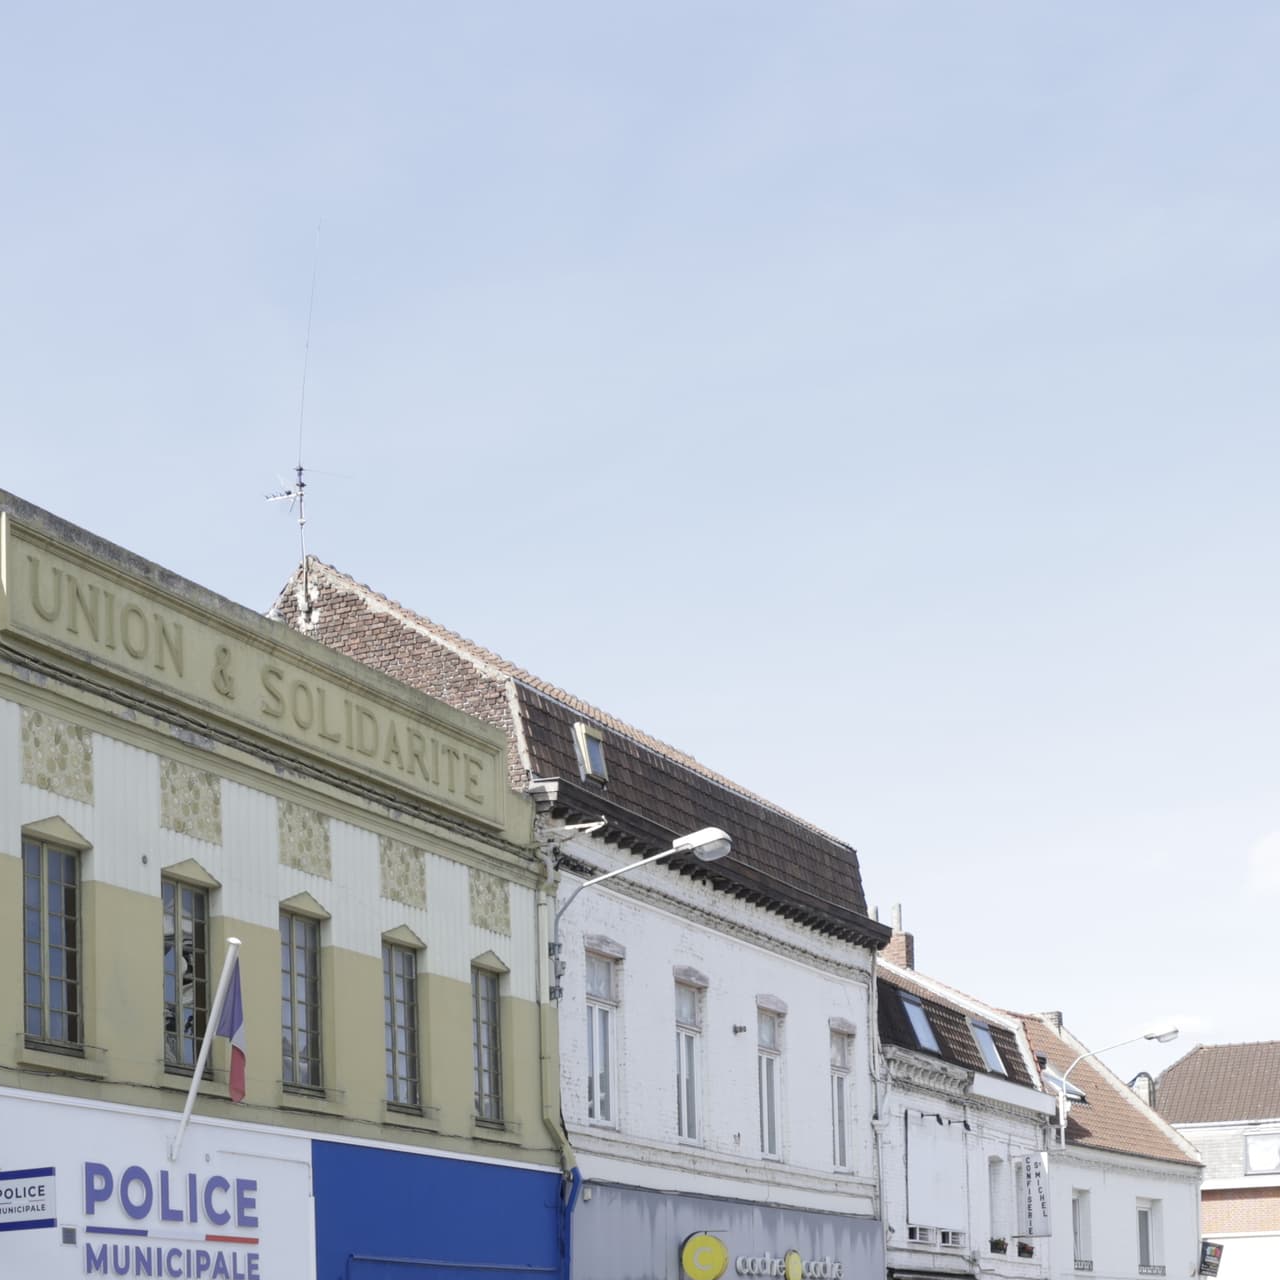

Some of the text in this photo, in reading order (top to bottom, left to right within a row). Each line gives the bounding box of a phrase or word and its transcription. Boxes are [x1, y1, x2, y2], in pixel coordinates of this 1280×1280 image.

[26, 555, 486, 804] UNION & SOLIDARITE
[84, 1160, 260, 1228] POLICE
[1035, 1171, 1048, 1218] MICHEL
